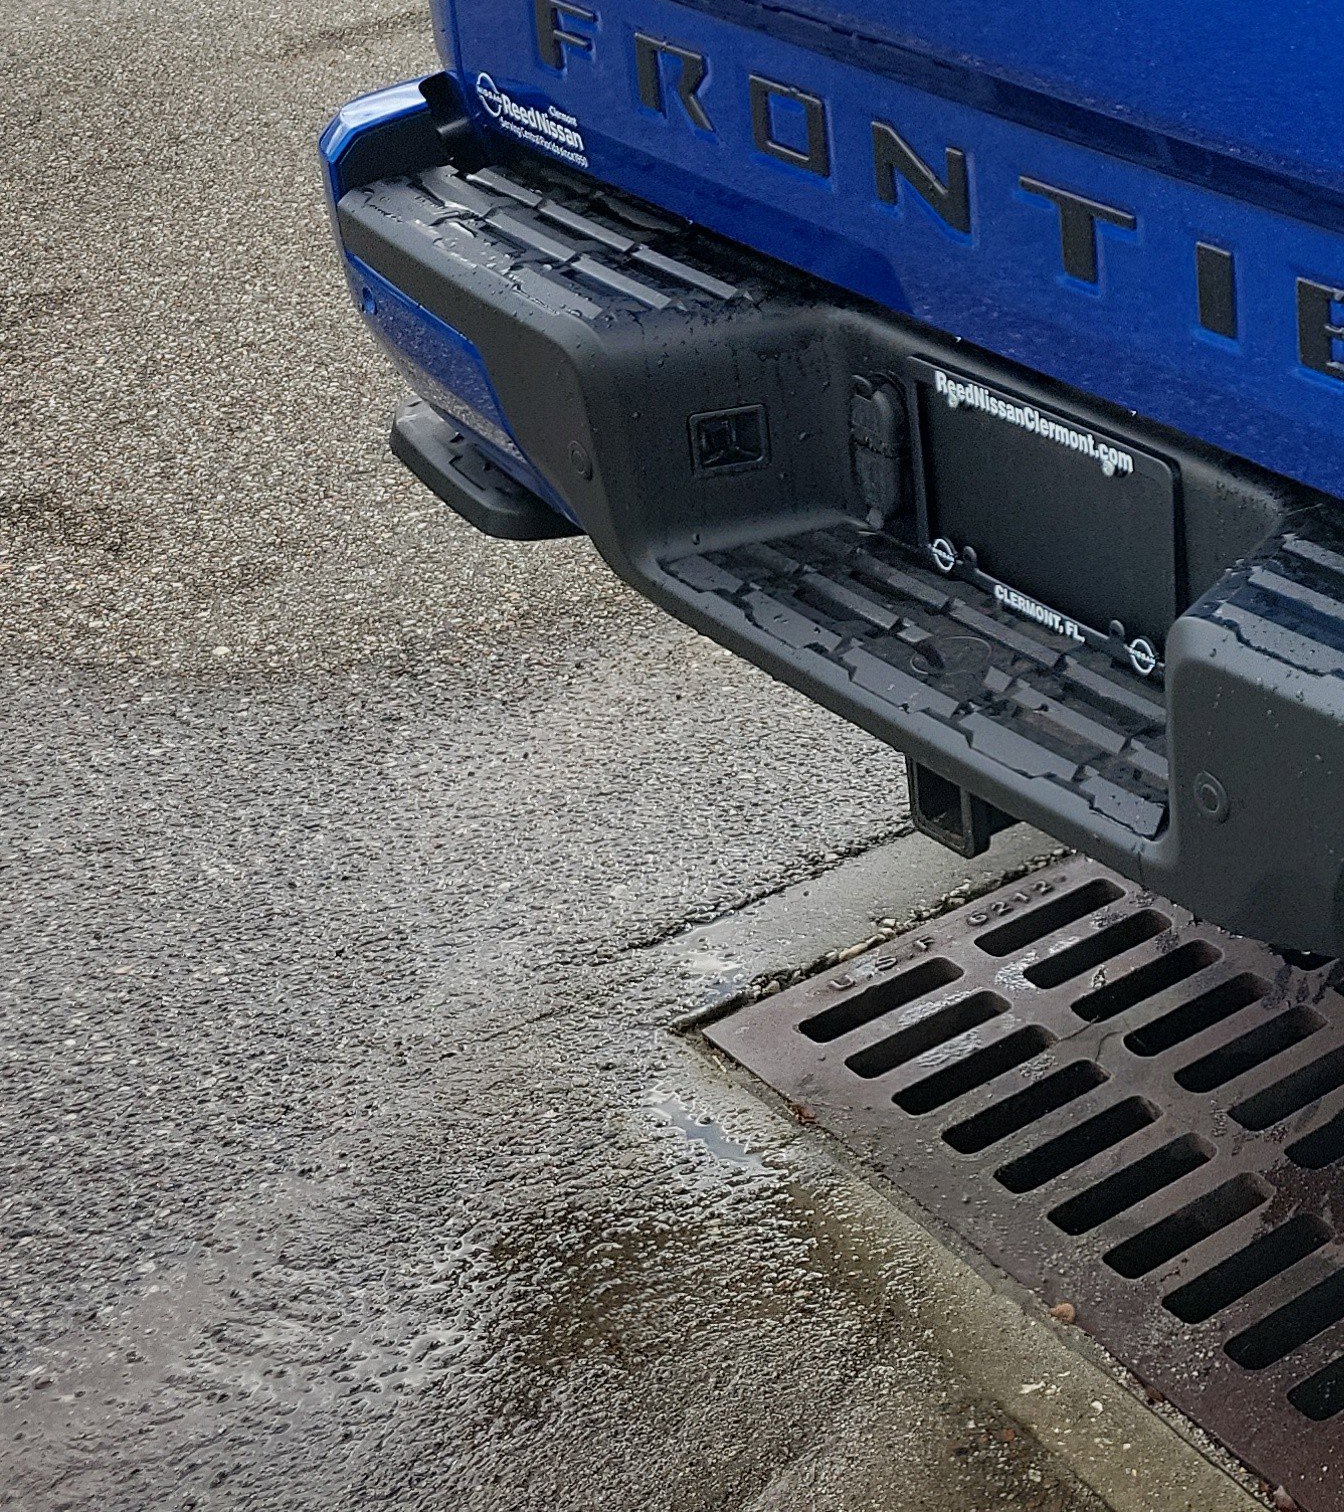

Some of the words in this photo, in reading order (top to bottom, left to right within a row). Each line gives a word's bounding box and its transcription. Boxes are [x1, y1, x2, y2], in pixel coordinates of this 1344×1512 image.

[501, 92, 584, 151] ReedNissan
[934, 370, 1134, 474] ReedNissanClermont.com
[994, 584, 1064, 635] CLERMONT,
